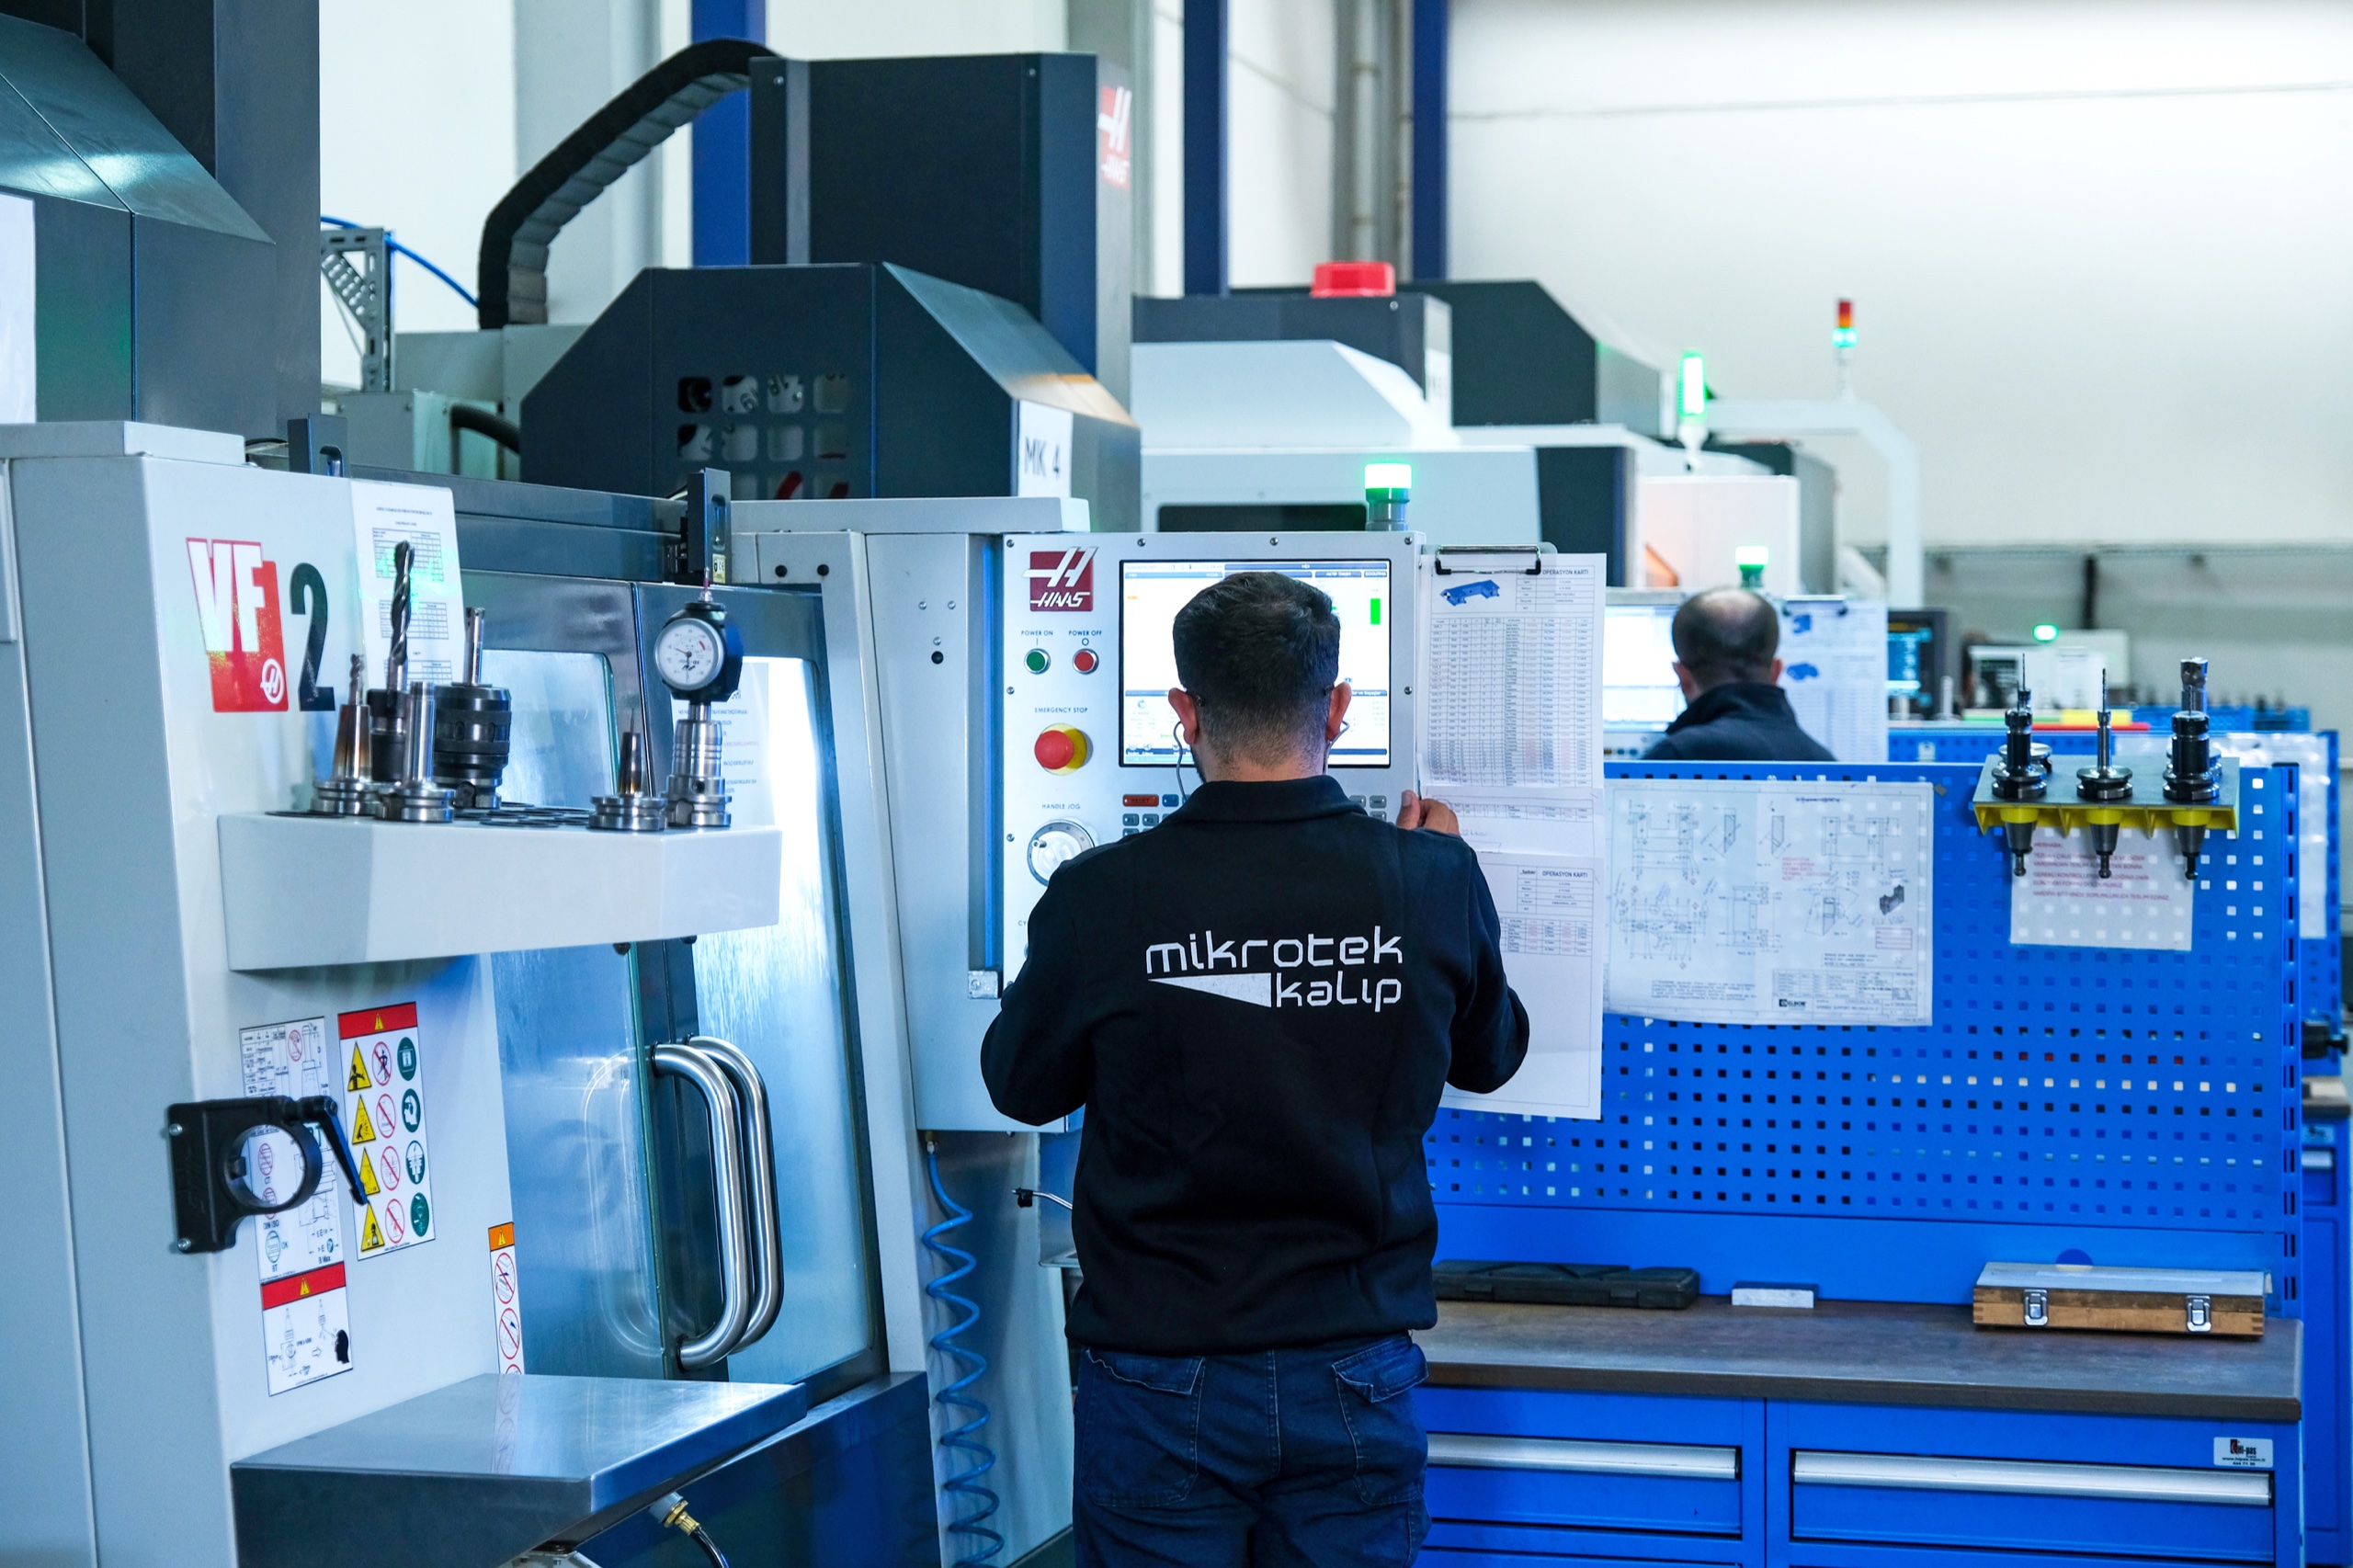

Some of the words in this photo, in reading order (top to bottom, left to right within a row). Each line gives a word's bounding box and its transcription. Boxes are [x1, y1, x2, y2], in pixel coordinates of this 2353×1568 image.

[1025, 437, 1046, 478] MK
[1030, 591, 1090, 608] HAAS
[1146, 926, 1403, 973] mikrotek
[263, 1221, 271, 1231] DIN
[271, 1219, 279, 1229] ISO
